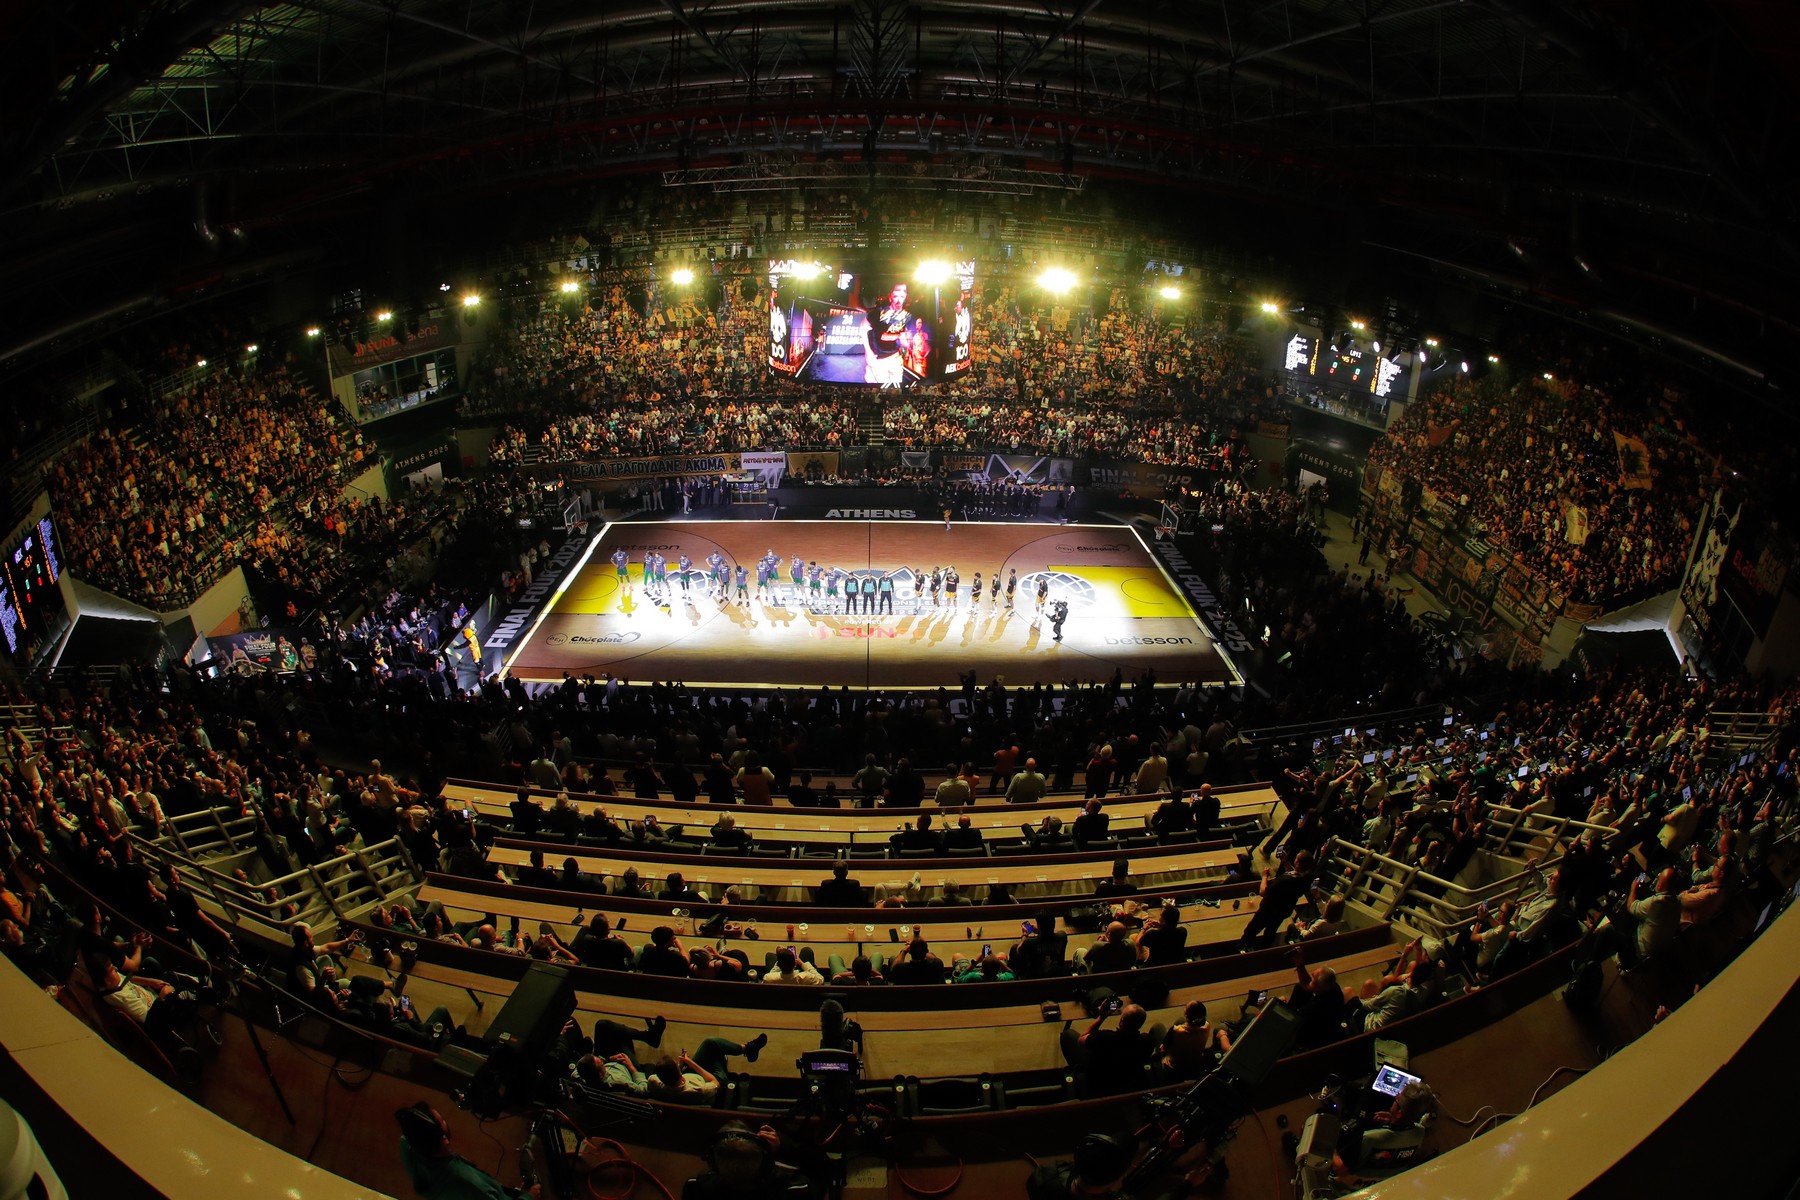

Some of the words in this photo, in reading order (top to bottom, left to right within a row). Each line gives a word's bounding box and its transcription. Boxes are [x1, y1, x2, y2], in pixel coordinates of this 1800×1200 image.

[394, 453, 426, 470] ATHENS
[684, 456, 726, 473] ΑΚΟΜΑ
[1299, 453, 1330, 468] ATHENS
[1332, 464, 1355, 478] 2025
[1090, 467, 1140, 485] FINAL
[824, 508, 917, 519] ATHENS
[484, 606, 537, 649] FINAL
[519, 567, 563, 603] FOUR
[552, 538, 586, 569] 2025
[1154, 541, 1194, 574] FINAL
[1178, 574, 1218, 609] FOUR
[1205, 609, 1255, 653] 2025
[1105, 635, 1194, 646] betsson
